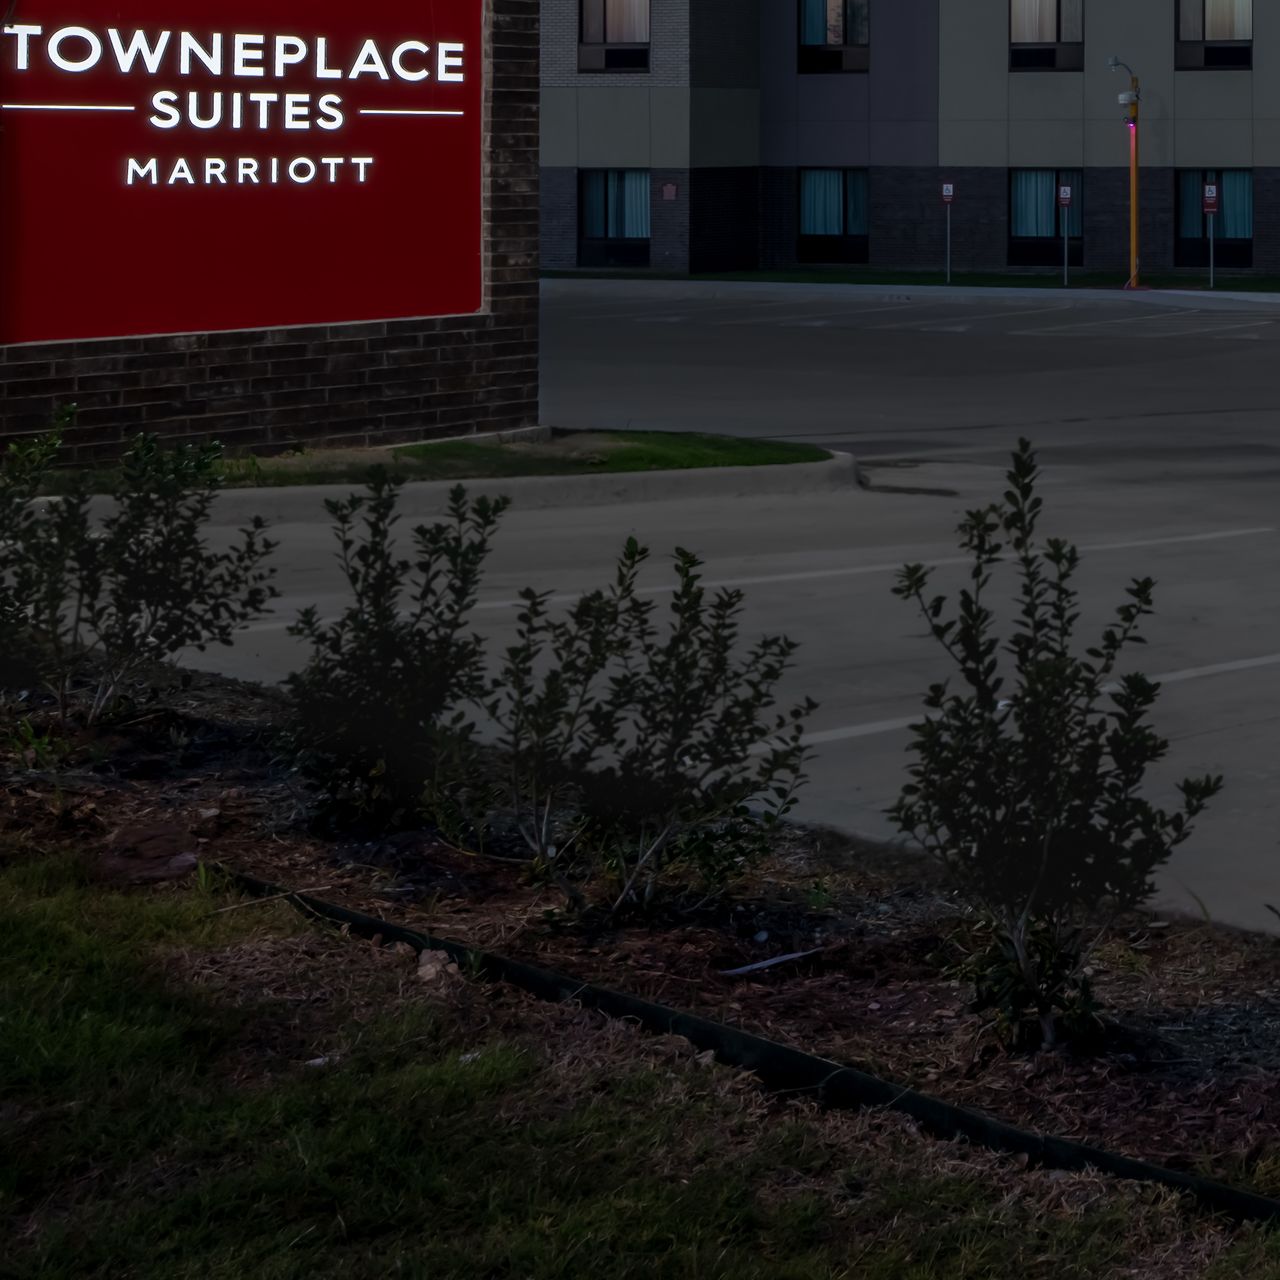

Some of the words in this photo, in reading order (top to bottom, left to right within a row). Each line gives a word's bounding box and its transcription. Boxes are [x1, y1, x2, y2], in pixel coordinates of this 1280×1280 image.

[3, 23, 466, 82] TOWNEPLACE
[149, 90, 345, 130] SUITES
[126, 156, 374, 185] MARRIOTT
